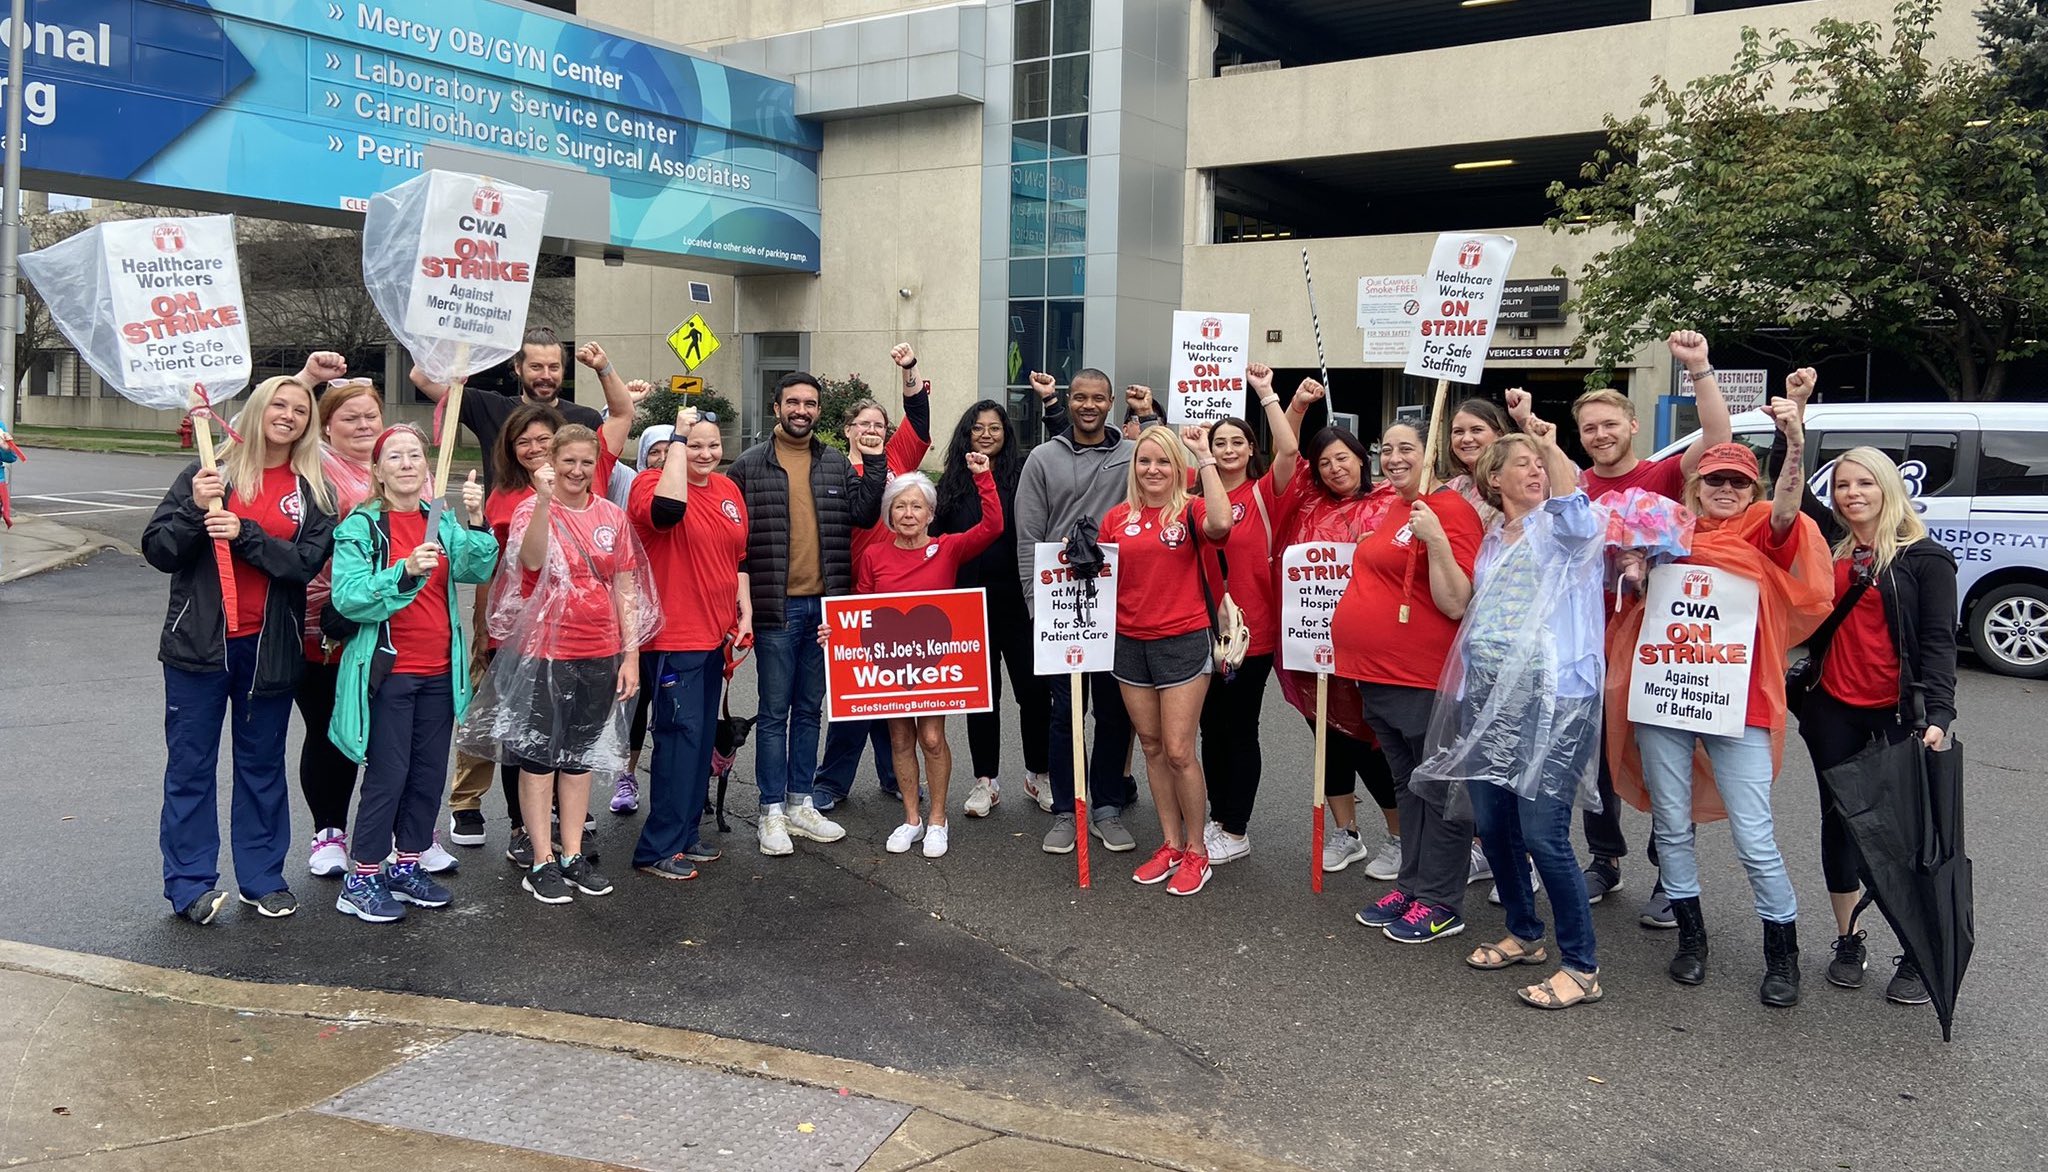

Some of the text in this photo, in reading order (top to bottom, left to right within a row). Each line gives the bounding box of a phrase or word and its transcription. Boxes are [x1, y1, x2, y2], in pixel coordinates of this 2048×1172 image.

[357, 3, 624, 91] Mercy OB/GYN Center
[354, 54, 677, 146] Laboratory Service Center
[354, 92, 751, 190] Cardiothoracic Surgical Associates
[477, 189, 500, 200] CWA
[155, 226, 180, 236] CWA
[459, 215, 508, 239] CWA
[454, 238, 499, 260] ON
[683, 236, 807, 264] Located on other side of parking ramp.
[122, 256, 223, 273] Healthcare
[421, 256, 530, 283] STRIKE
[136, 273, 213, 288] Workers
[1435, 270, 1493, 286] Healthcare
[450, 284, 494, 303] Against
[1439, 284, 1484, 300] Workers
[1524, 284, 1560, 293] Available
[151, 291, 201, 318] ON
[426, 295, 511, 321] Mercy Hospital
[1441, 300, 1469, 317] ON
[122, 305, 241, 344] STRIKE
[438, 315, 494, 335] of Buffalo
[1420, 318, 1488, 337] STRIKE
[146, 339, 223, 357] For Safe
[1182, 341, 1239, 352] Healthcare
[1423, 340, 1472, 359] For Safe
[1489, 349, 1533, 357] VEHICLES
[1536, 349, 1560, 357] OVER
[201, 354, 243, 367] Care
[1188, 352, 1232, 363] Workers
[1193, 364, 1220, 377] ON
[1421, 355, 1467, 378] Staffing
[1177, 378, 1243, 393] STRIKE
[1718, 372, 1763, 384] RESTRICTED
[1184, 396, 1232, 409] For Safe
[1185, 408, 1230, 420] Staffing
[1306, 547, 1336, 563] ON
[1950, 546, 1992, 562] CES
[1287, 564, 1353, 582] STRIK
[1685, 573, 1709, 583] CWA
[1051, 588, 1063, 597] at
[1299, 586, 1311, 595] at
[1052, 599, 1098, 612] Hospital
[1671, 601, 1720, 621] CWA
[837, 609, 872, 629] WE
[1053, 618, 1069, 629] for
[1301, 616, 1318, 627] for
[1040, 630, 1108, 641] Patient Care
[1288, 628, 1330, 640] Patient
[1666, 623, 1712, 644] ON
[834, 639, 980, 663] Mercy, St. Joe's, Kenmore
[1639, 643, 1747, 665] STRIKE
[853, 663, 963, 688] Workers
[1665, 669, 1709, 687] Against
[1644, 682, 1730, 706] Mercy Hospital
[851, 699, 966, 713] SafeStaffingBuffalo.org
[1656, 701, 1713, 721] of Buffalo
